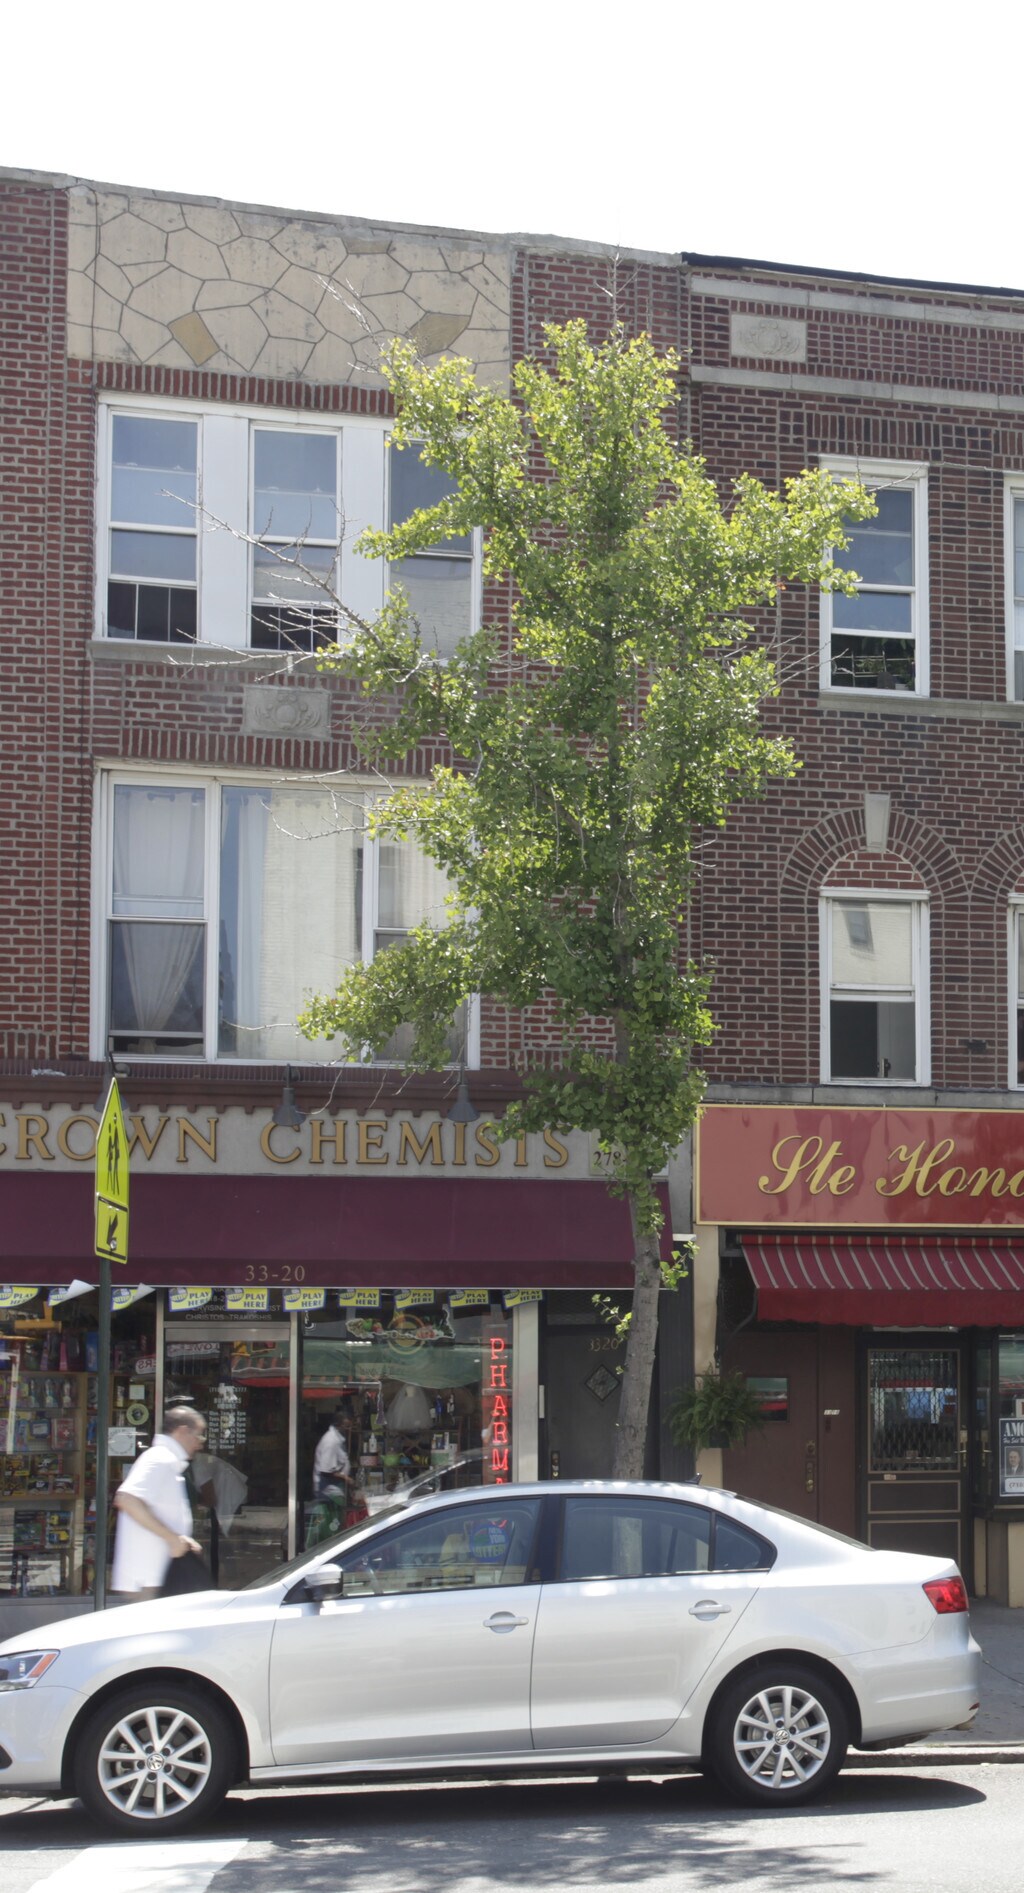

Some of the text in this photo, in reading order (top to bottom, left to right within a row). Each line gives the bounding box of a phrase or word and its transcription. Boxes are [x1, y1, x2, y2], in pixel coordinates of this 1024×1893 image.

[0, 1114, 569, 1168] ROWN CHEMISTS
[758, 1135, 856, 1196] Ste
[245, 1265, 305, 1282] 33-20
[189, 1291, 210, 1299] PLAY
[302, 1292, 322, 1300] PLAY
[489, 1337, 509, 1485] PHARM
